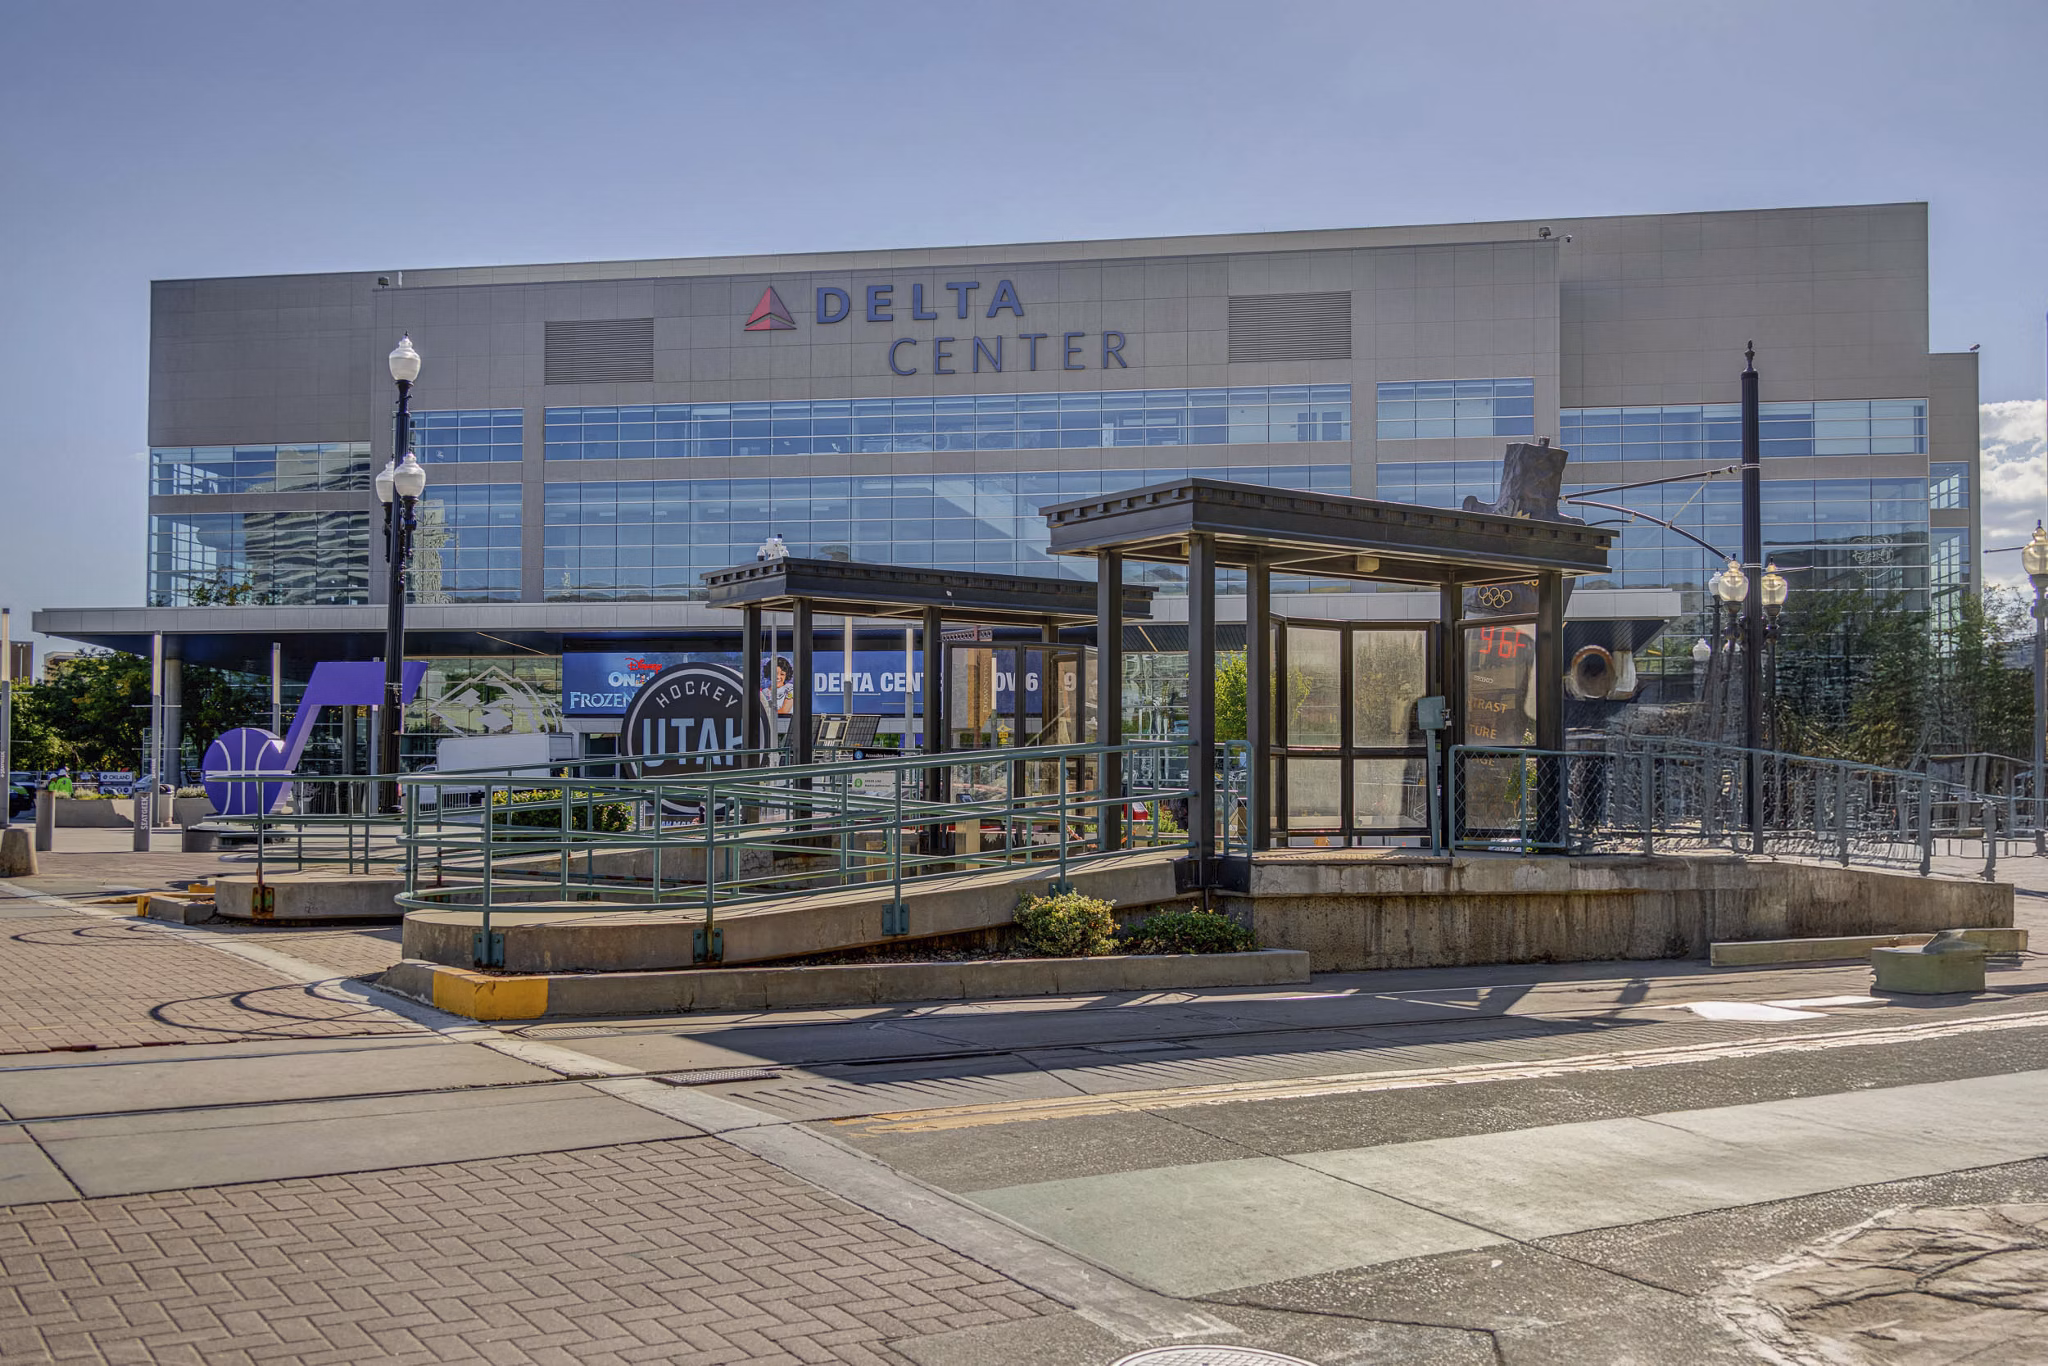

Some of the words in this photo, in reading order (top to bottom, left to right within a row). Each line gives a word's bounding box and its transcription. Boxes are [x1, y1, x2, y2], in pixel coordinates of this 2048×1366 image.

[816, 280, 1025, 324] DELTA
[889, 330, 1128, 376] CENTER
[656, 681, 739, 709] HOCKEY
[880, 672, 924, 692] CEN
[996, 672, 1016, 692] OV
[643, 717, 744, 768] UTAH
[141, 796, 149, 830] SEATGEEK
